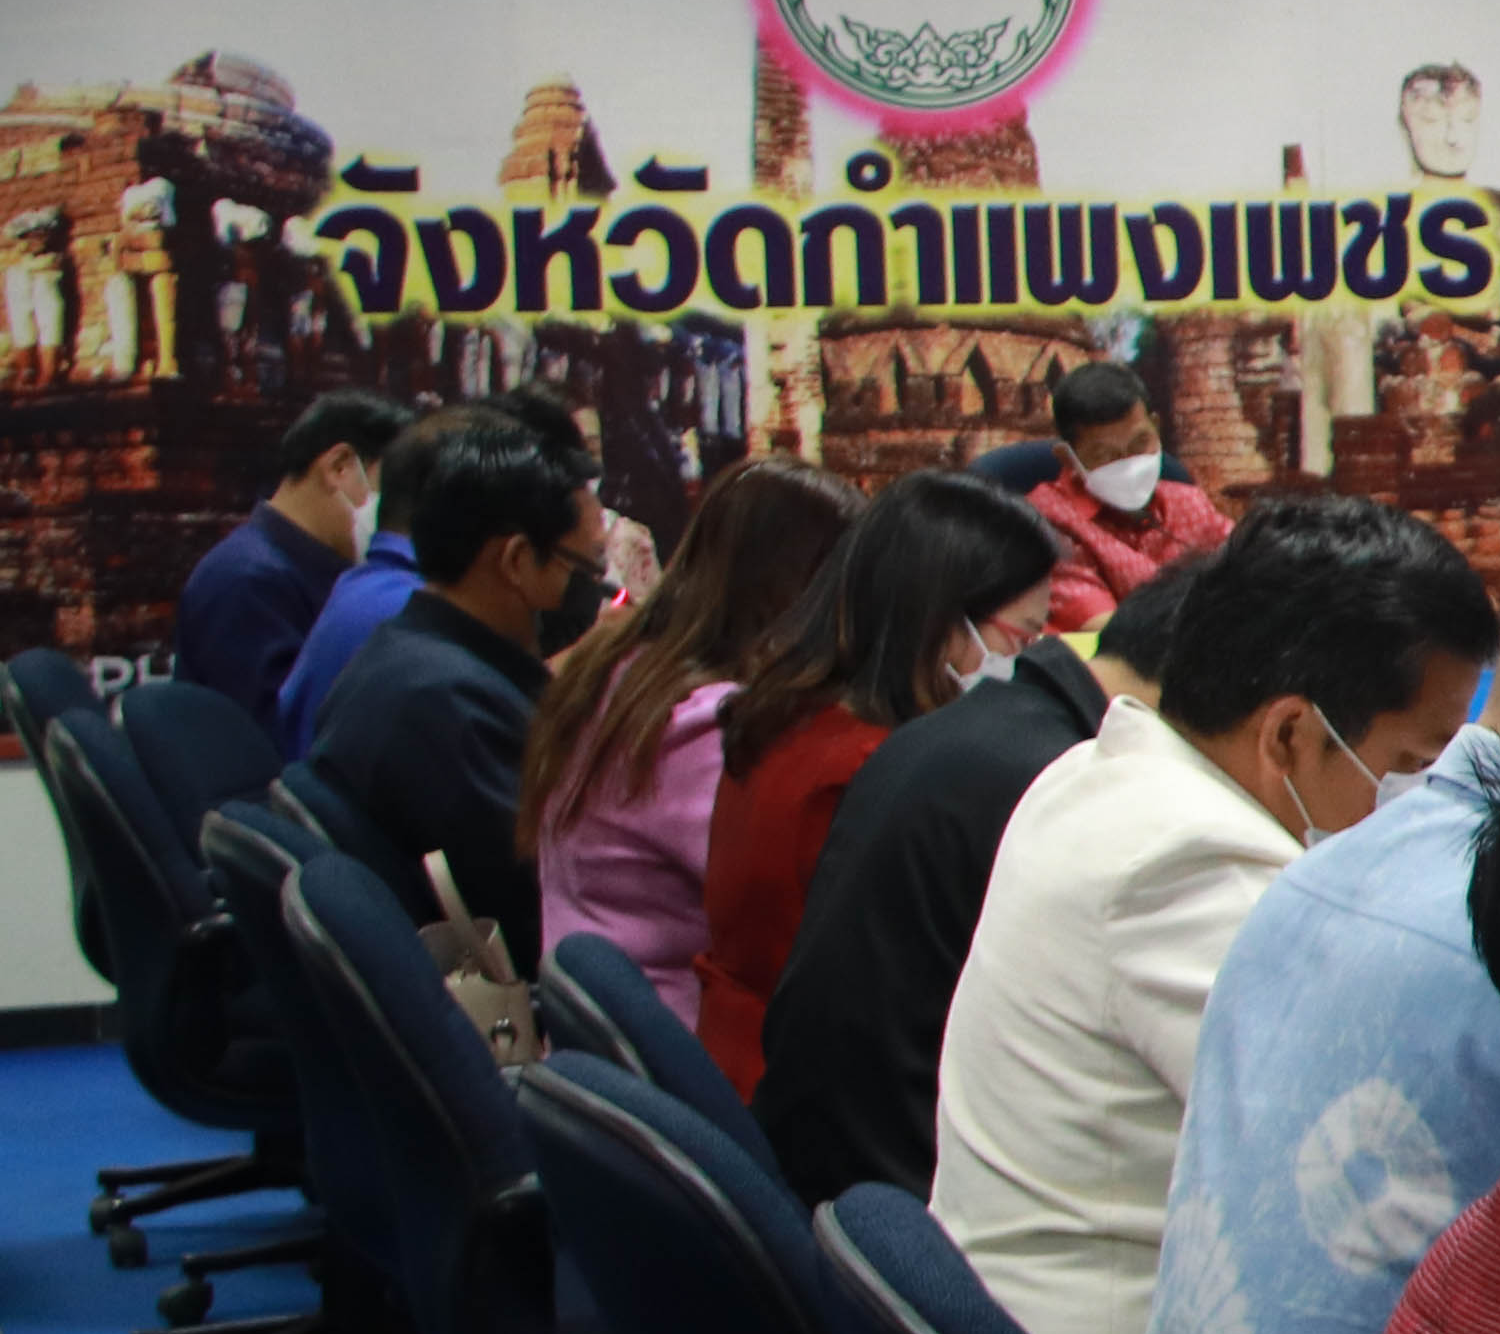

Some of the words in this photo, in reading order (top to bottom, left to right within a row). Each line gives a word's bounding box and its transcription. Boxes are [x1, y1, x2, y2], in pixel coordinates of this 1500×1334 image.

[315, 152, 1494, 315] จังหวัดกำแพงเพชร
